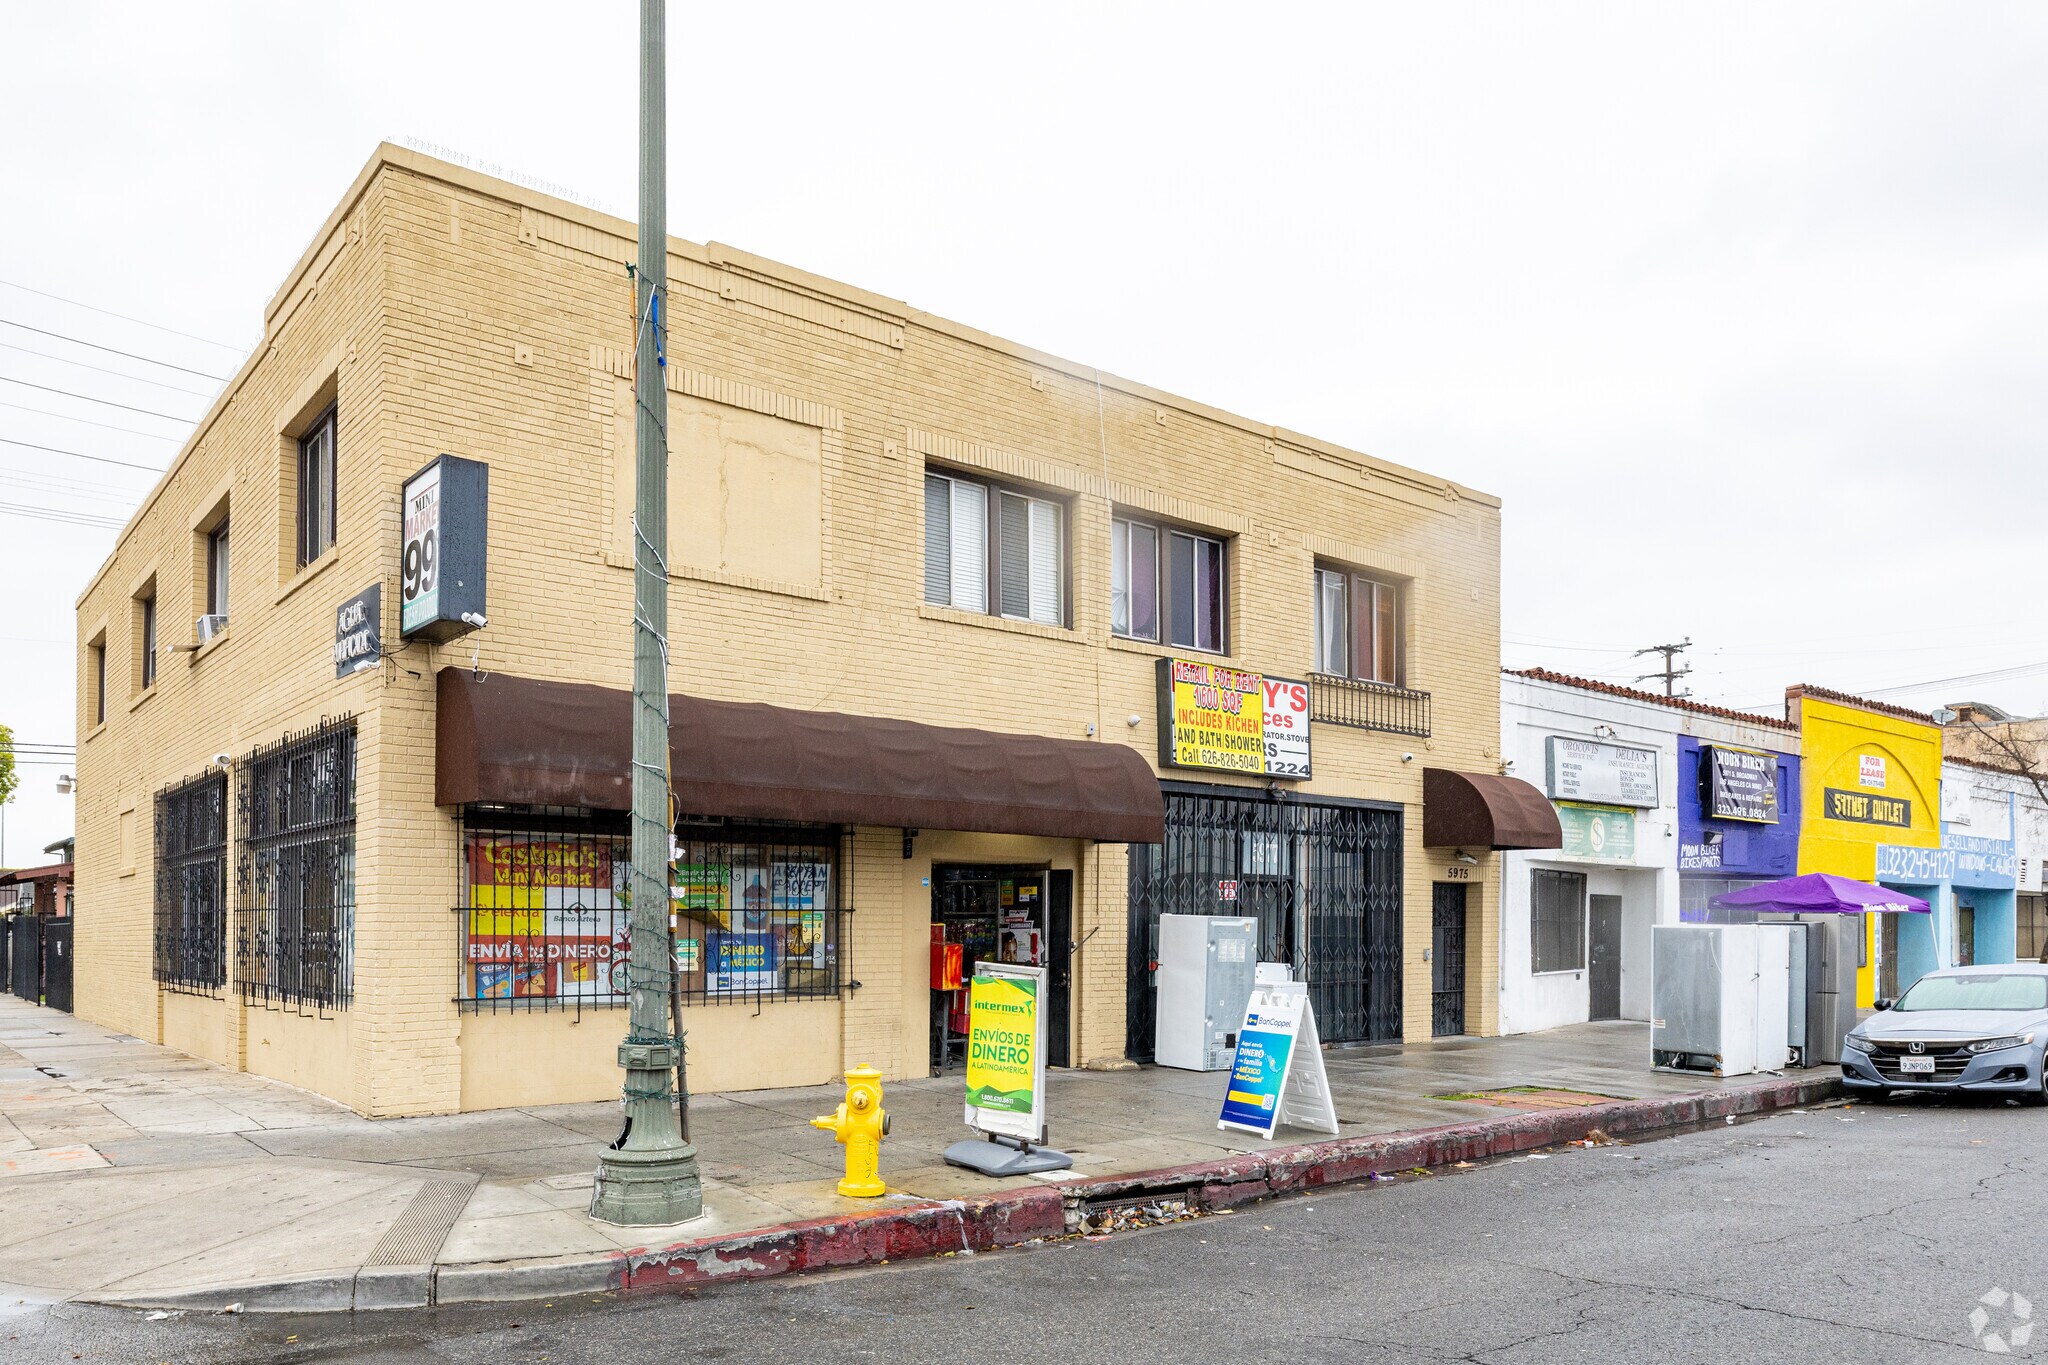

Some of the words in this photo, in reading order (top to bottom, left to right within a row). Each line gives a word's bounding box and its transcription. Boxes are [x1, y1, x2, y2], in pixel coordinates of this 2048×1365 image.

[414, 489, 434, 514] MINI
[405, 505, 438, 542] MARKE
[1175, 661, 1211, 687] RETAIL
[1213, 667, 1233, 690] FOR
[1235, 671, 1261, 695] RENT
[1194, 685, 1220, 711] 1600
[1221, 690, 1243, 716] SQF
[1178, 708, 1223, 730] INCLUDES
[1225, 715, 1259, 734] KICHEN
[1177, 727, 1196, 745] AND
[1181, 746, 1200, 764] Call
[1201, 748, 1260, 771] 626-826-5040
[1615, 748, 1647, 763] DELIA'S
[1717, 750, 1741, 767] MOON
[1741, 755, 1765, 772] BIKER
[1864, 756, 1881, 767] FOR
[1608, 759, 1635, 769] INSURANCE
[1636, 762, 1655, 772] AGENCY
[1860, 767, 1885, 779] LEASE
[1717, 803, 1767, 819] 323.496.0824
[1872, 799, 1904, 824] OUTLET
[485, 841, 600, 869] Castaño's
[1680, 843, 1699, 857] MOON
[1701, 844, 1721, 856] BIKER
[1680, 857, 1721, 869] BIKES/PARTS
[494, 867, 530, 885] Mni
[534, 869, 593, 887] Market
[1447, 868, 1469, 879] 5975
[1887, 902, 1910, 912] Biker
[553, 915, 577, 923] Banco
[469, 941, 523, 959] ENVÍA
[547, 943, 611, 960] DNERO
[721, 945, 765, 956] DNERO
[728, 956, 765, 967] MÉXICO
[974, 1000, 1025, 1014] intermex
[1258, 1016, 1292, 1028] BanCoppel
[973, 1027, 1015, 1046] ENVÍOS
[1015, 1033, 1031, 1047] DE
[971, 1042, 1030, 1065] DINERO
[1902, 1062, 1933, 1071] 9JNP069
